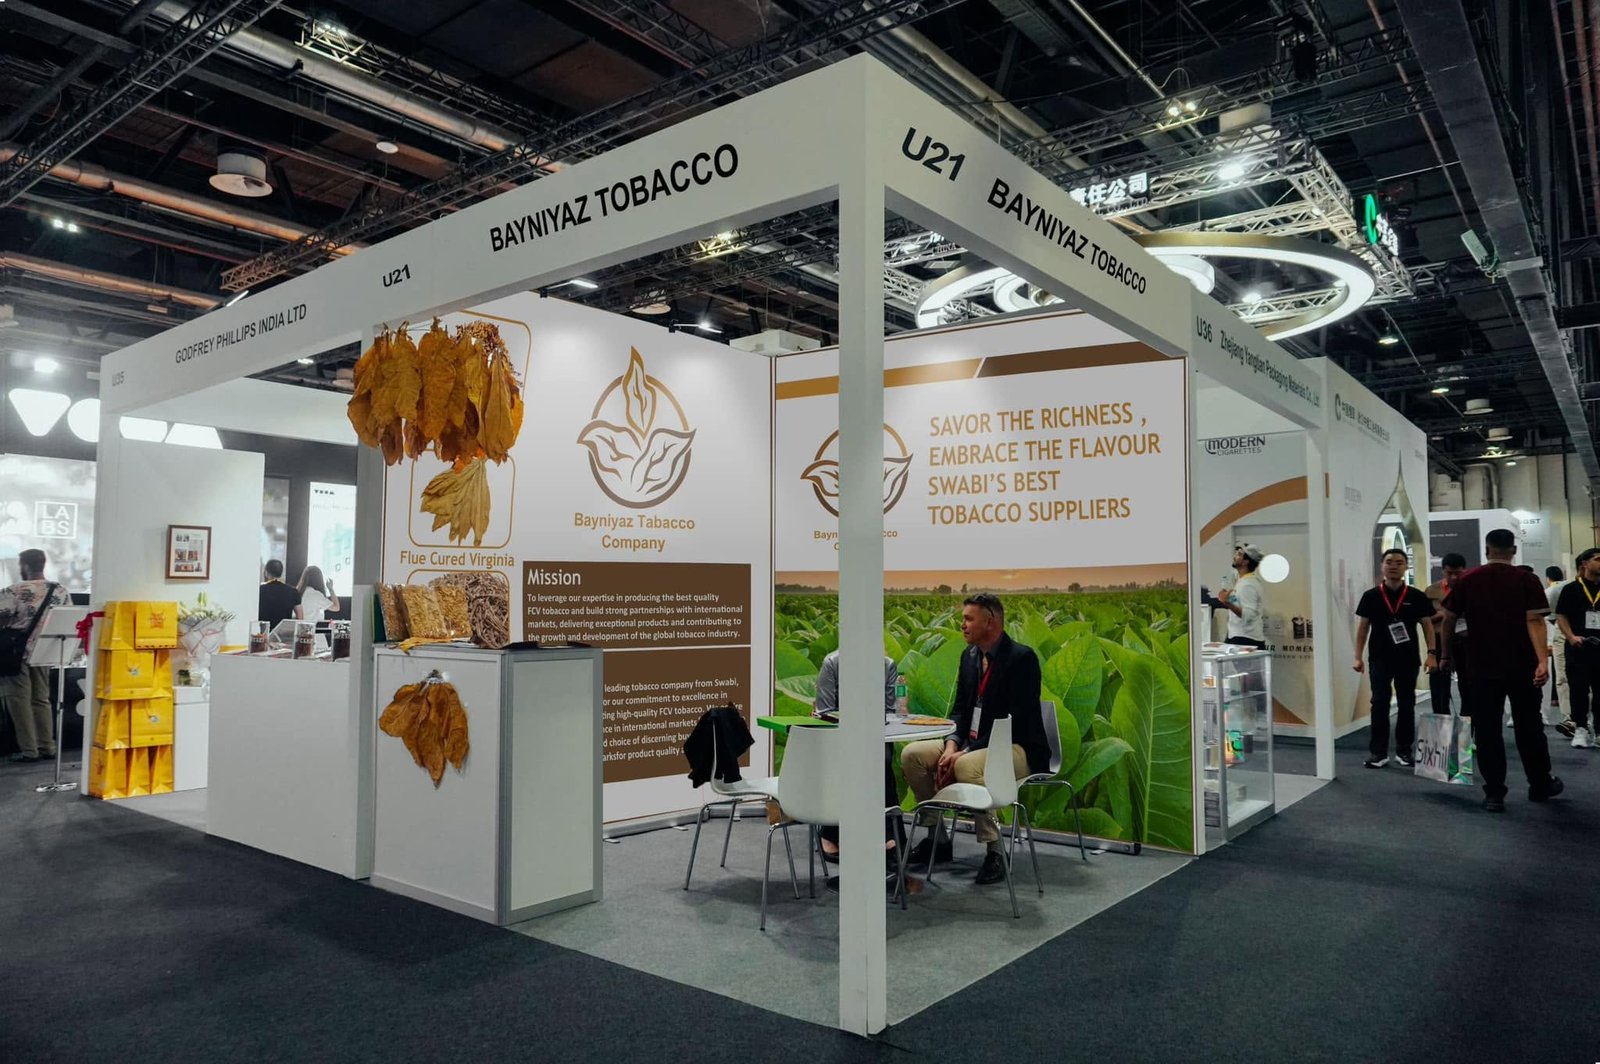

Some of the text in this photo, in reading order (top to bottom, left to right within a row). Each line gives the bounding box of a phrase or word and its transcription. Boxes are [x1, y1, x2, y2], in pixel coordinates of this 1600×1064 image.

[490, 144, 738, 252] BAYNIYAZ TOBACCO
[902, 127, 1147, 294] U21 BAYNIYAZ TOBACCO
[383, 264, 411, 288] U21
[175, 303, 307, 364] GODFREY PHILLIPS INDIA LTD
[1196, 316, 1213, 343] U36
[112, 371, 125, 387] U35
[930, 412, 992, 437] SAVOR
[997, 409, 1035, 432] THE
[1041, 402, 1133, 429] RICHNESS
[929, 433, 1161, 467] EMBRACE THE FLAVOUR
[928, 470, 1061, 496] SWABI'S BEST
[927, 497, 1131, 525] TOBACCO SUPPLIERS
[574, 512, 696, 530] Bayniyaz Tabacco
[601, 535, 666, 552] Company
[813, 530, 839, 541] Bayn
[400, 551, 515, 569] Flue Cured Virginia
[527, 568, 581, 586] Mission
[527, 594, 537, 602] To
[538, 594, 568, 604] leverage
[582, 594, 615, 604] expertise
[616, 593, 623, 602] in
[625, 593, 661, 603] producing
[662, 593, 674, 601] the
[676, 593, 691, 601] best
[693, 593, 720, 603] quality
[527, 605, 743, 616] FCV tobacco and build strong partnerships with international
[527, 620, 558, 629] markets,
[559, 620, 594, 629] delivering
[595, 619, 637, 629] exceptional
[638, 619, 670, 628] products
[671, 618, 685, 626] and
[686, 617, 732, 627] contributing
[528, 630, 741, 643] the growth and development of the global tobacco industry.
[604, 683, 630, 693] leading
[631, 682, 659, 691] tobacco
[660, 681, 694, 691] company
[695, 679, 713, 688] from
[602, 691, 728, 706] or our commitment to excellence in
[616, 707, 658, 720] high-quality
[659, 707, 673, 716] FCV
[674, 704, 705, 715] tobacco.
[613, 725, 621, 734] in
[622, 720, 668, 732] international
[669, 718, 697, 728] markets
[609, 738, 631, 748] choice
[632, 735, 641, 745] of
[641, 733, 677, 744] discerning
[627, 749, 655, 760] product
[655, 746, 680, 758] quality
